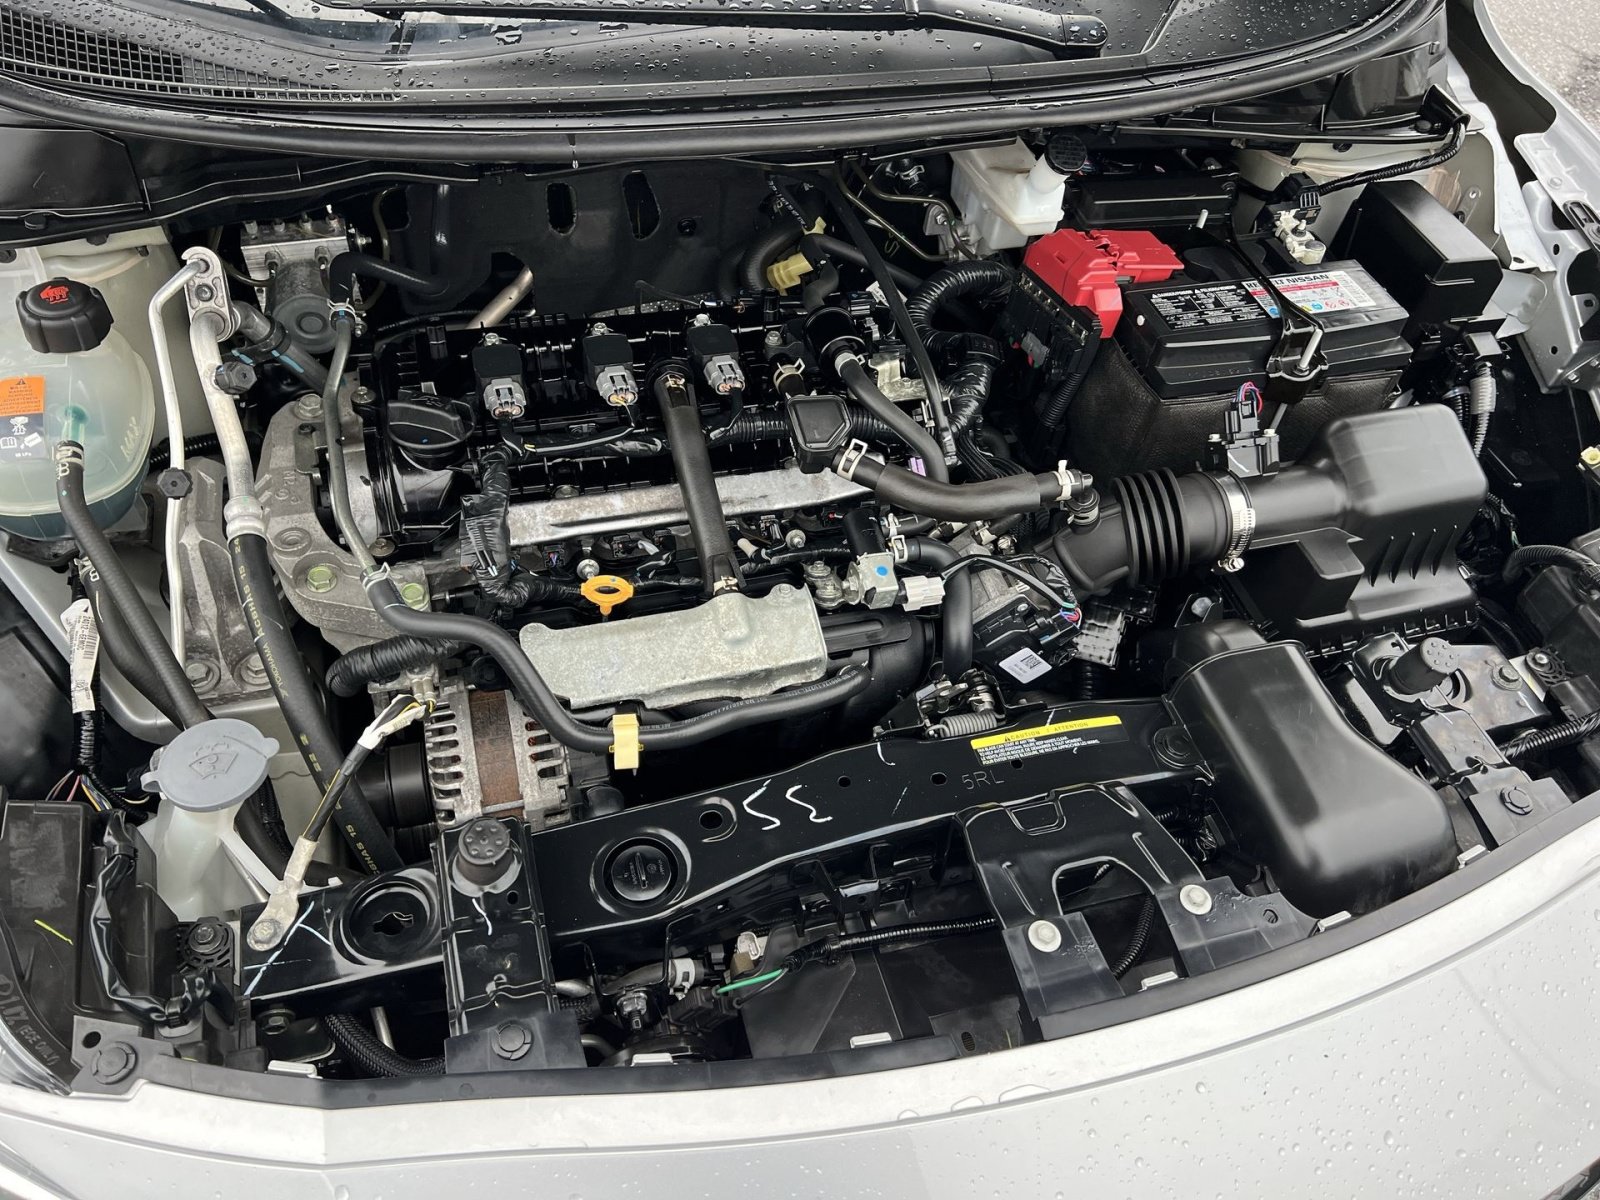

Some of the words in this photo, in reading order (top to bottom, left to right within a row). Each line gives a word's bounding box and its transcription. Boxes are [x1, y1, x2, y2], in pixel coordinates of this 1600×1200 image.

[1246, 279, 1285, 288] RELT
[1286, 273, 1329, 284] NISSAN
[238, 565, 248, 580] 15
[261, 641, 285, 688] YOKOHAMA
[1011, 731, 1041, 740] CAUTION
[1054, 723, 1088, 731] ATTENTION
[961, 769, 1005, 789] 5RL
[345, 824, 358, 838] 15
